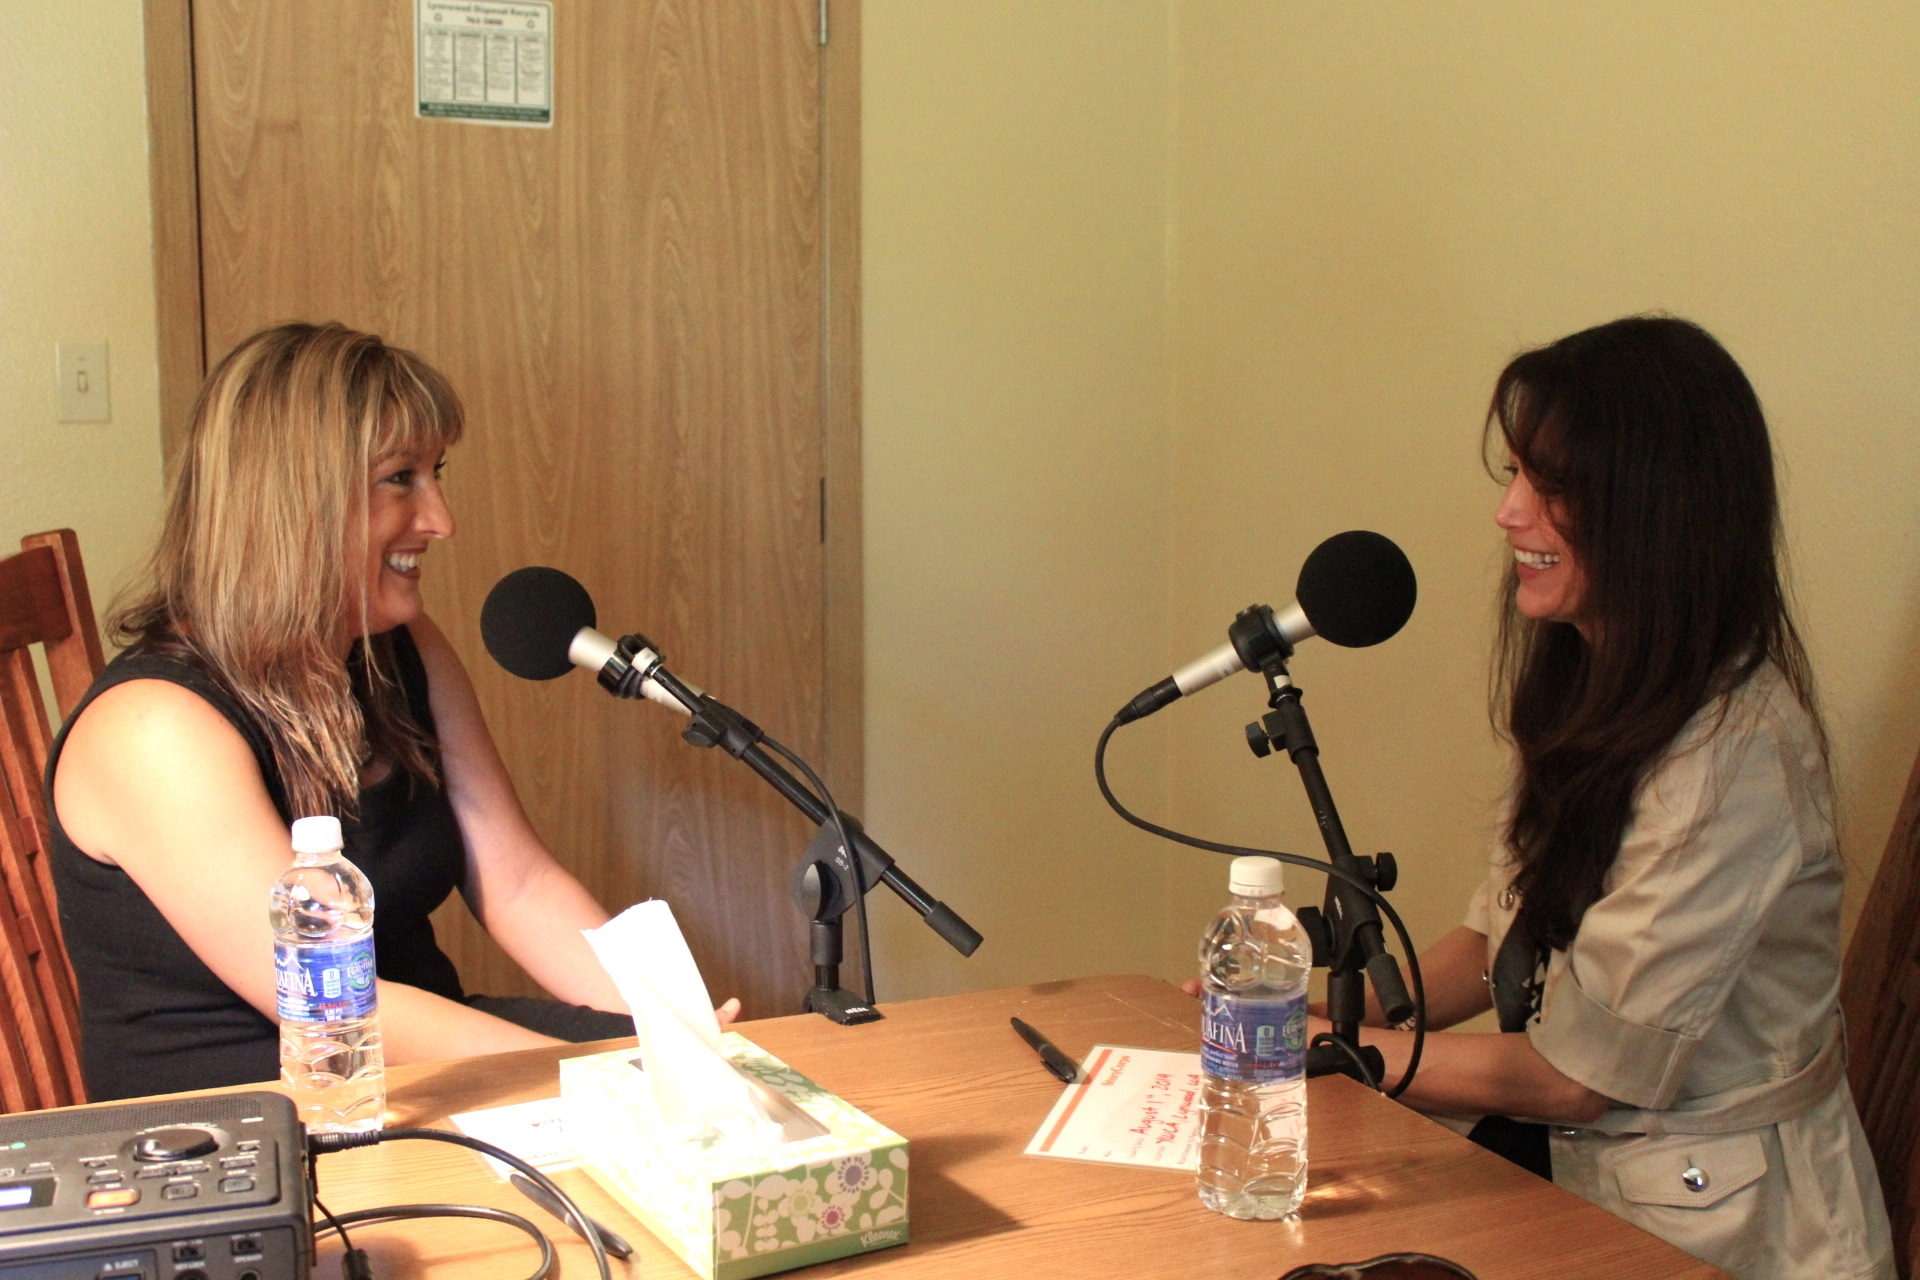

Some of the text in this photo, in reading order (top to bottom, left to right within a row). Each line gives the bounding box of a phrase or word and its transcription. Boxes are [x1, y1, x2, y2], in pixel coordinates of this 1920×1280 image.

[275, 966, 317, 997] UAFINA
[330, 970, 335, 979] 0
[1201, 1015, 1247, 1054] UAFINA
[1264, 1027, 1270, 1037] 0
[1129, 1107, 1165, 1136] August
[860, 1230, 901, 1248] Kleenex
